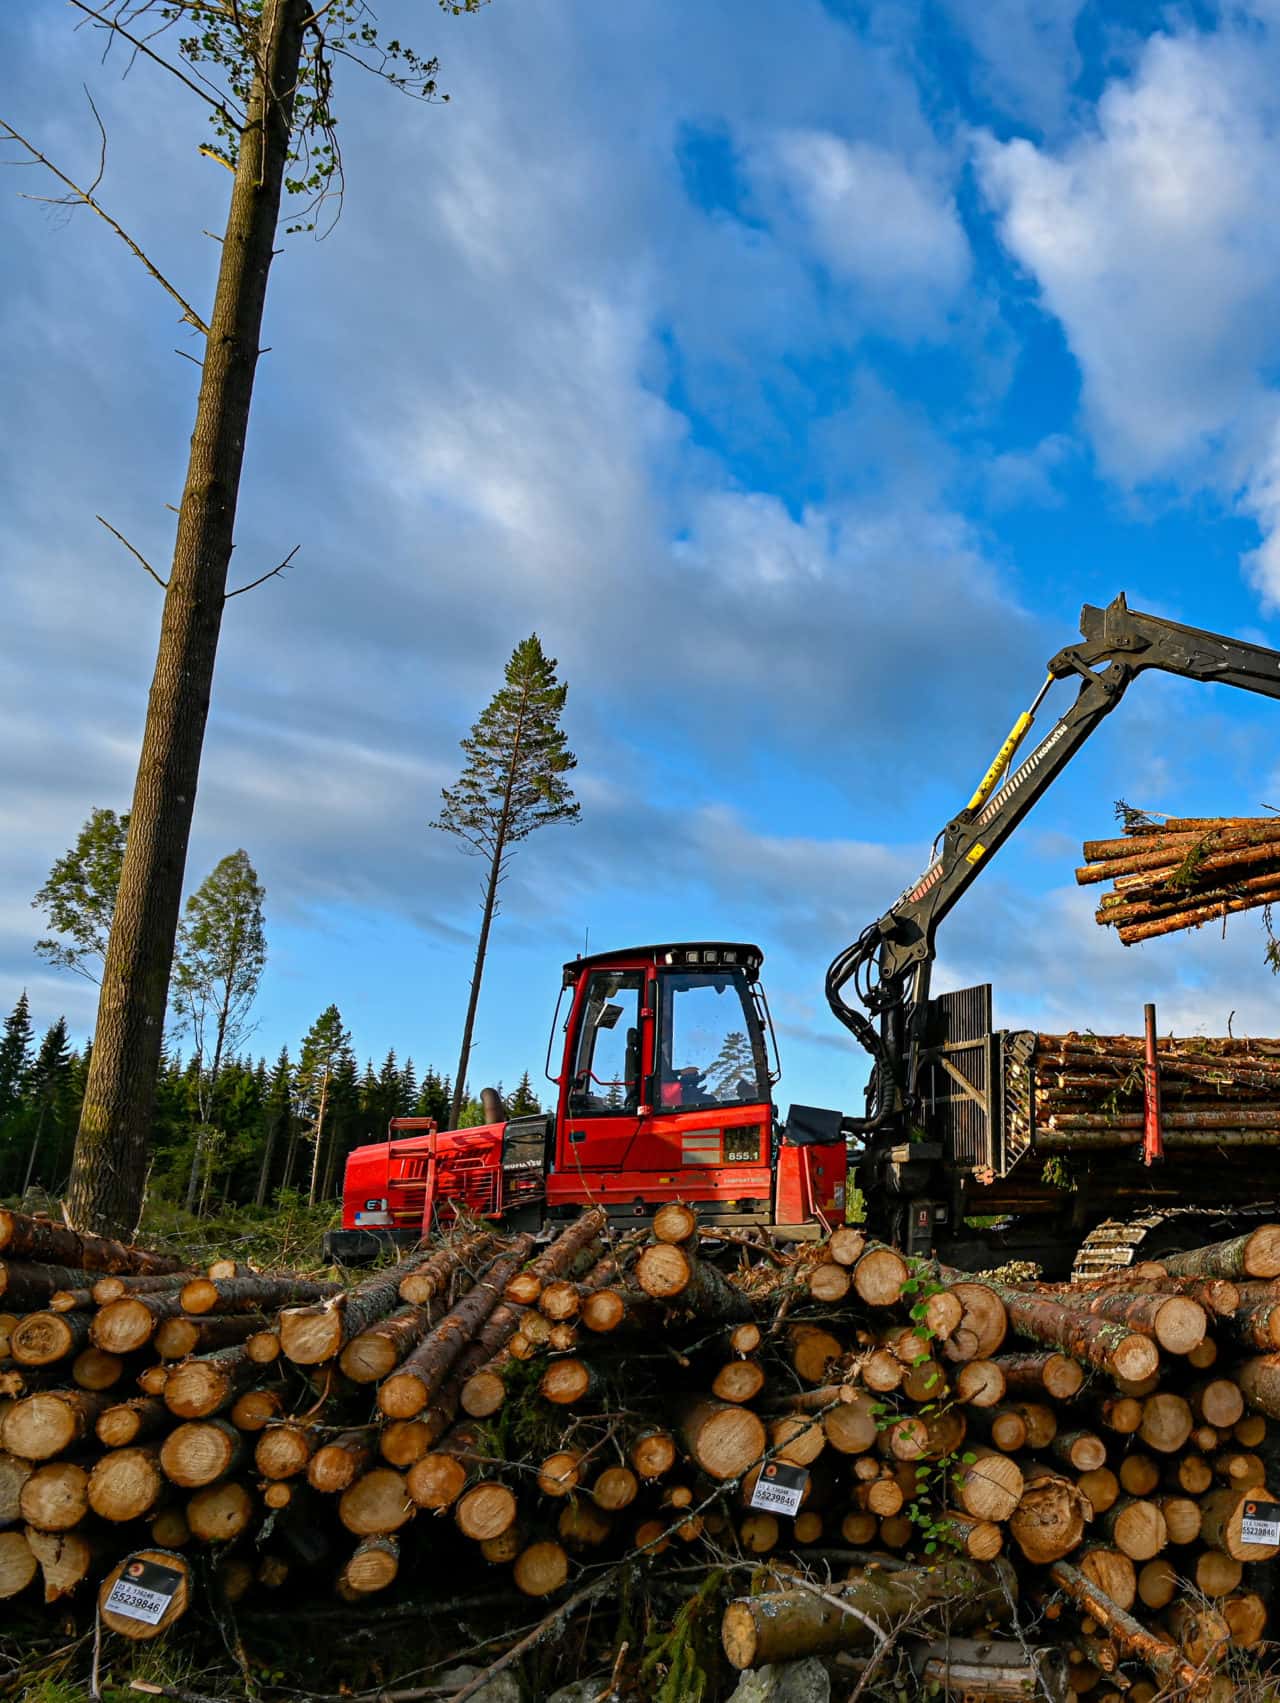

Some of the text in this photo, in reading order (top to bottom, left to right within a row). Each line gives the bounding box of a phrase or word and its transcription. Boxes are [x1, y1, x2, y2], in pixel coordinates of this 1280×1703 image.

[1037, 724, 1068, 759] KOMATSU
[728, 1151, 758, 1161] 855.1
[111, 1591, 161, 1613] 55239846
